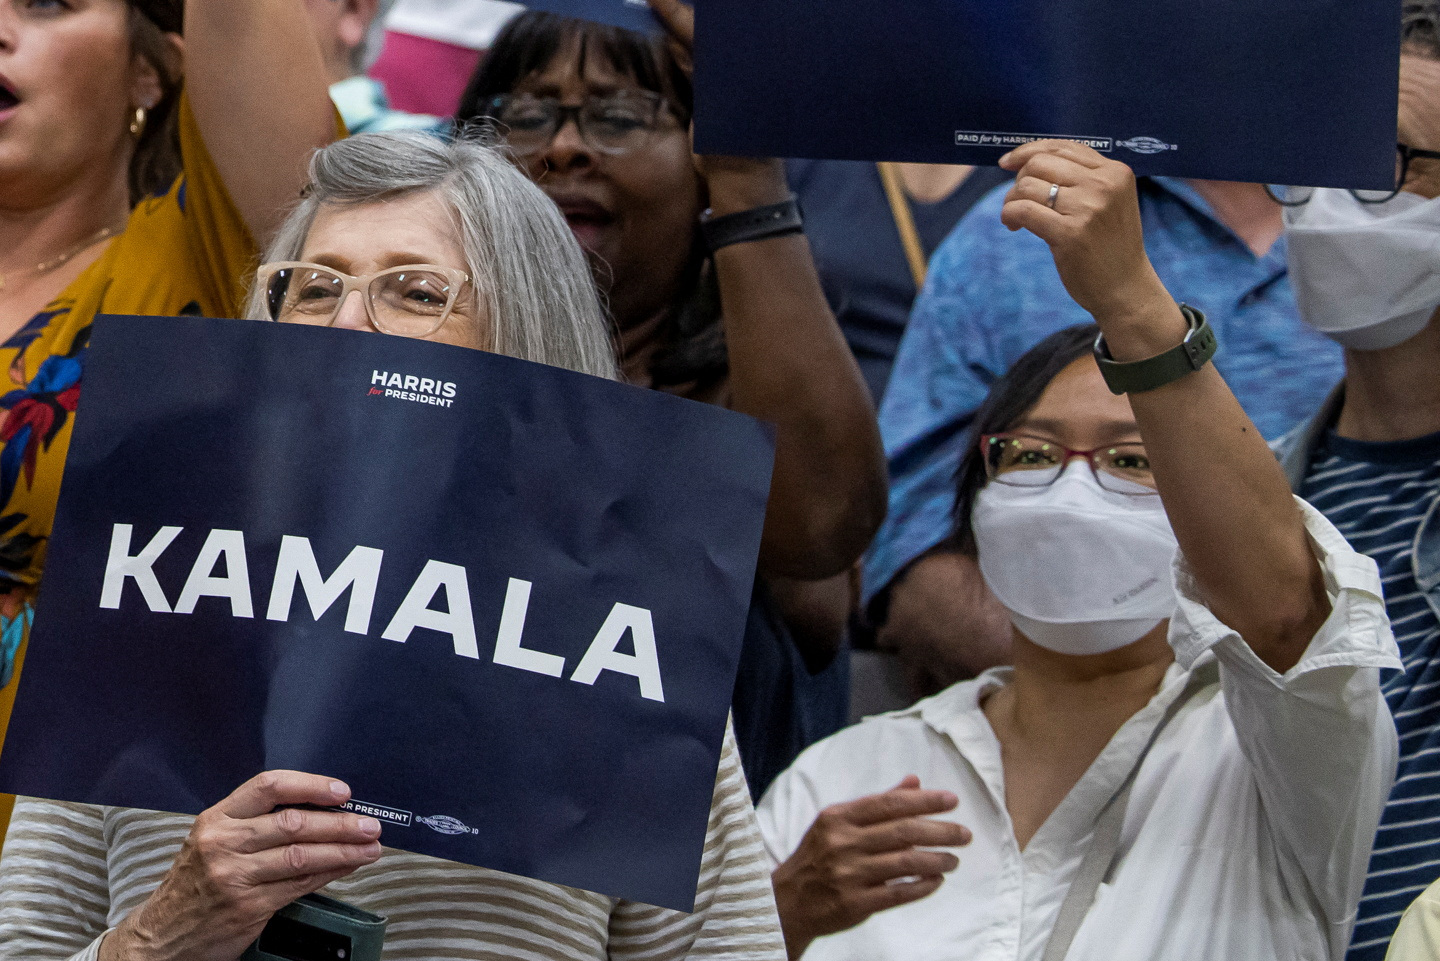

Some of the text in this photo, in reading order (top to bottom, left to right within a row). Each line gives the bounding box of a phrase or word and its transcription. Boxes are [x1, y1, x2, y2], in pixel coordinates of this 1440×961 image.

[957, 134, 978, 142] PAID
[978, 134, 992, 144] for
[992, 135, 1003, 145] by
[371, 369, 457, 398] HARRIS
[366, 386, 454, 408] for PRESIDENT
[99, 523, 665, 703] KAMALA
[339, 802, 409, 822] OR PRESIDENT
